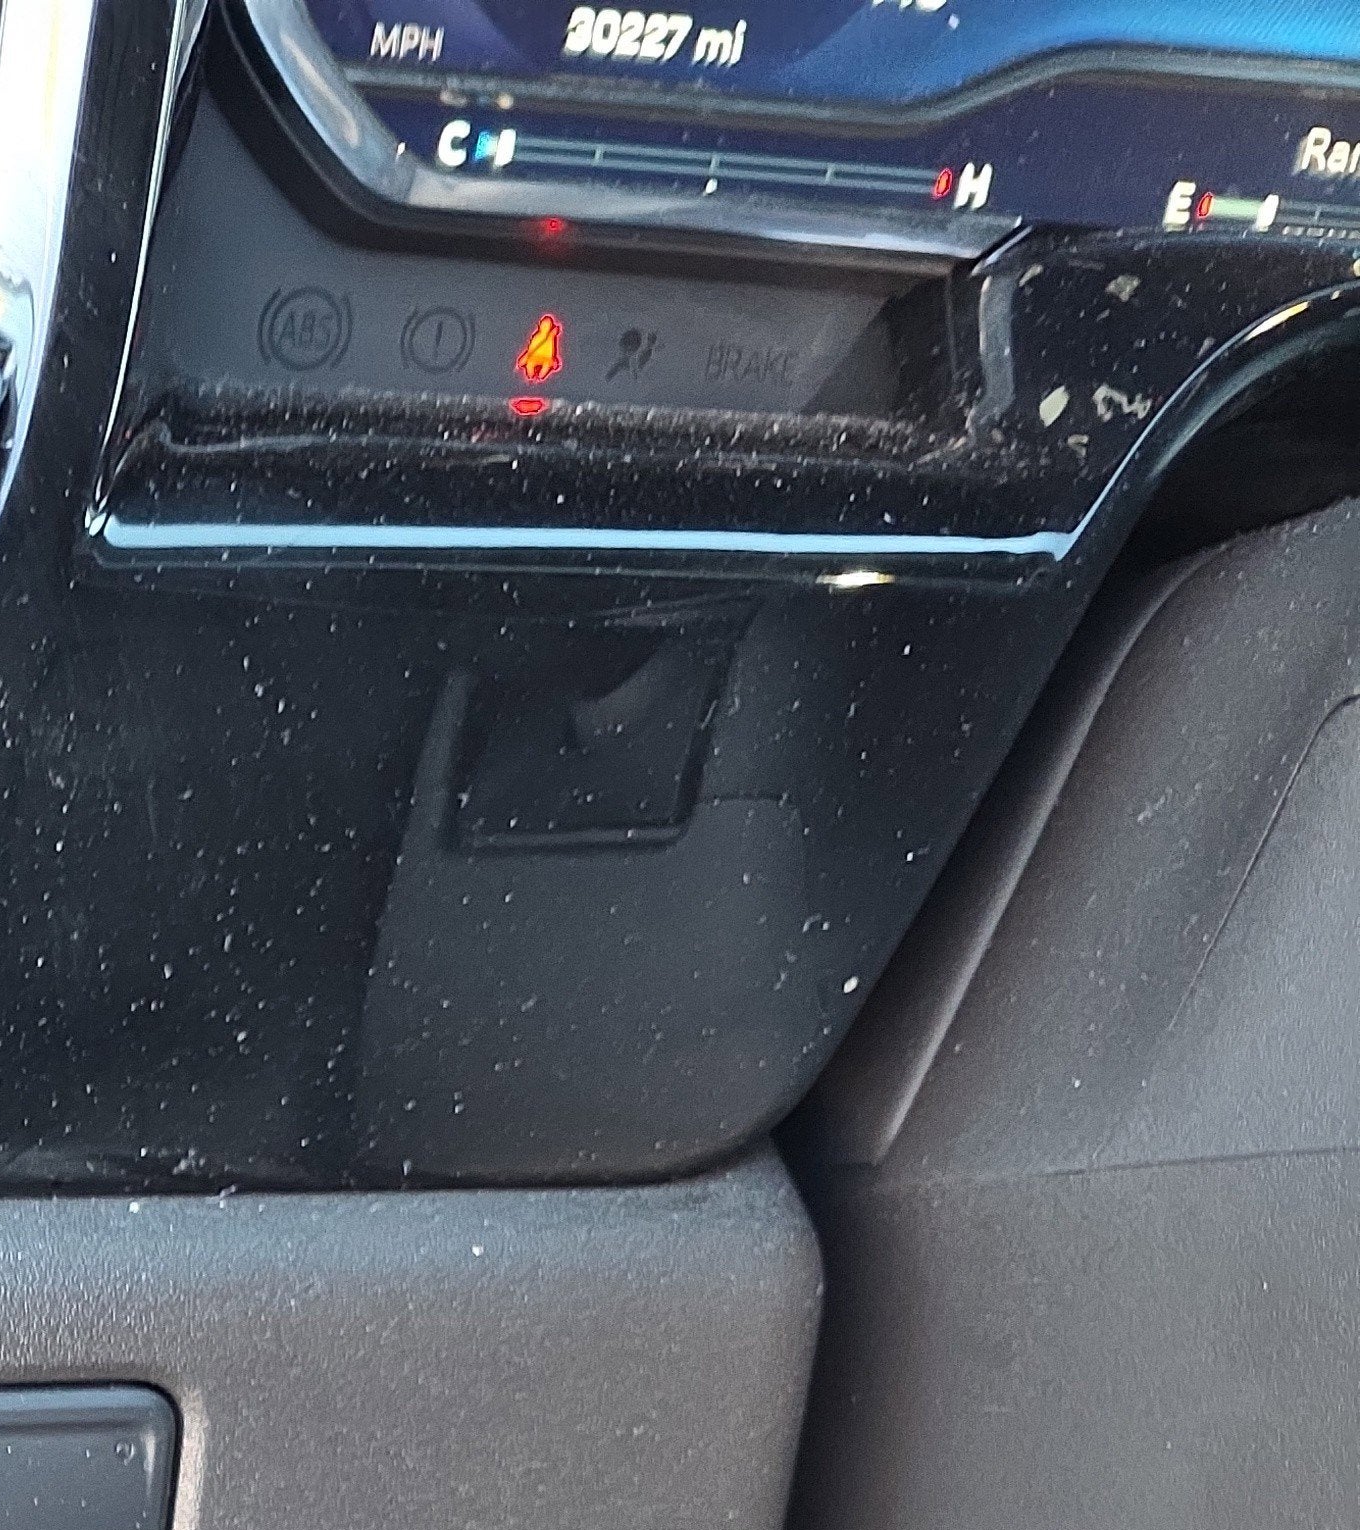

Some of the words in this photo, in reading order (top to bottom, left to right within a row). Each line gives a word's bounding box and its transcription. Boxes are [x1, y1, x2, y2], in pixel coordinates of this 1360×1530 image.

[370, 22, 444, 61] MPH
[694, 18, 747, 66] mi
[437, 120, 471, 168] C
[953, 161, 994, 209] H
[1163, 180, 1197, 230] E
[277, 310, 334, 350] ABS
[704, 340, 799, 388] BRAKE
